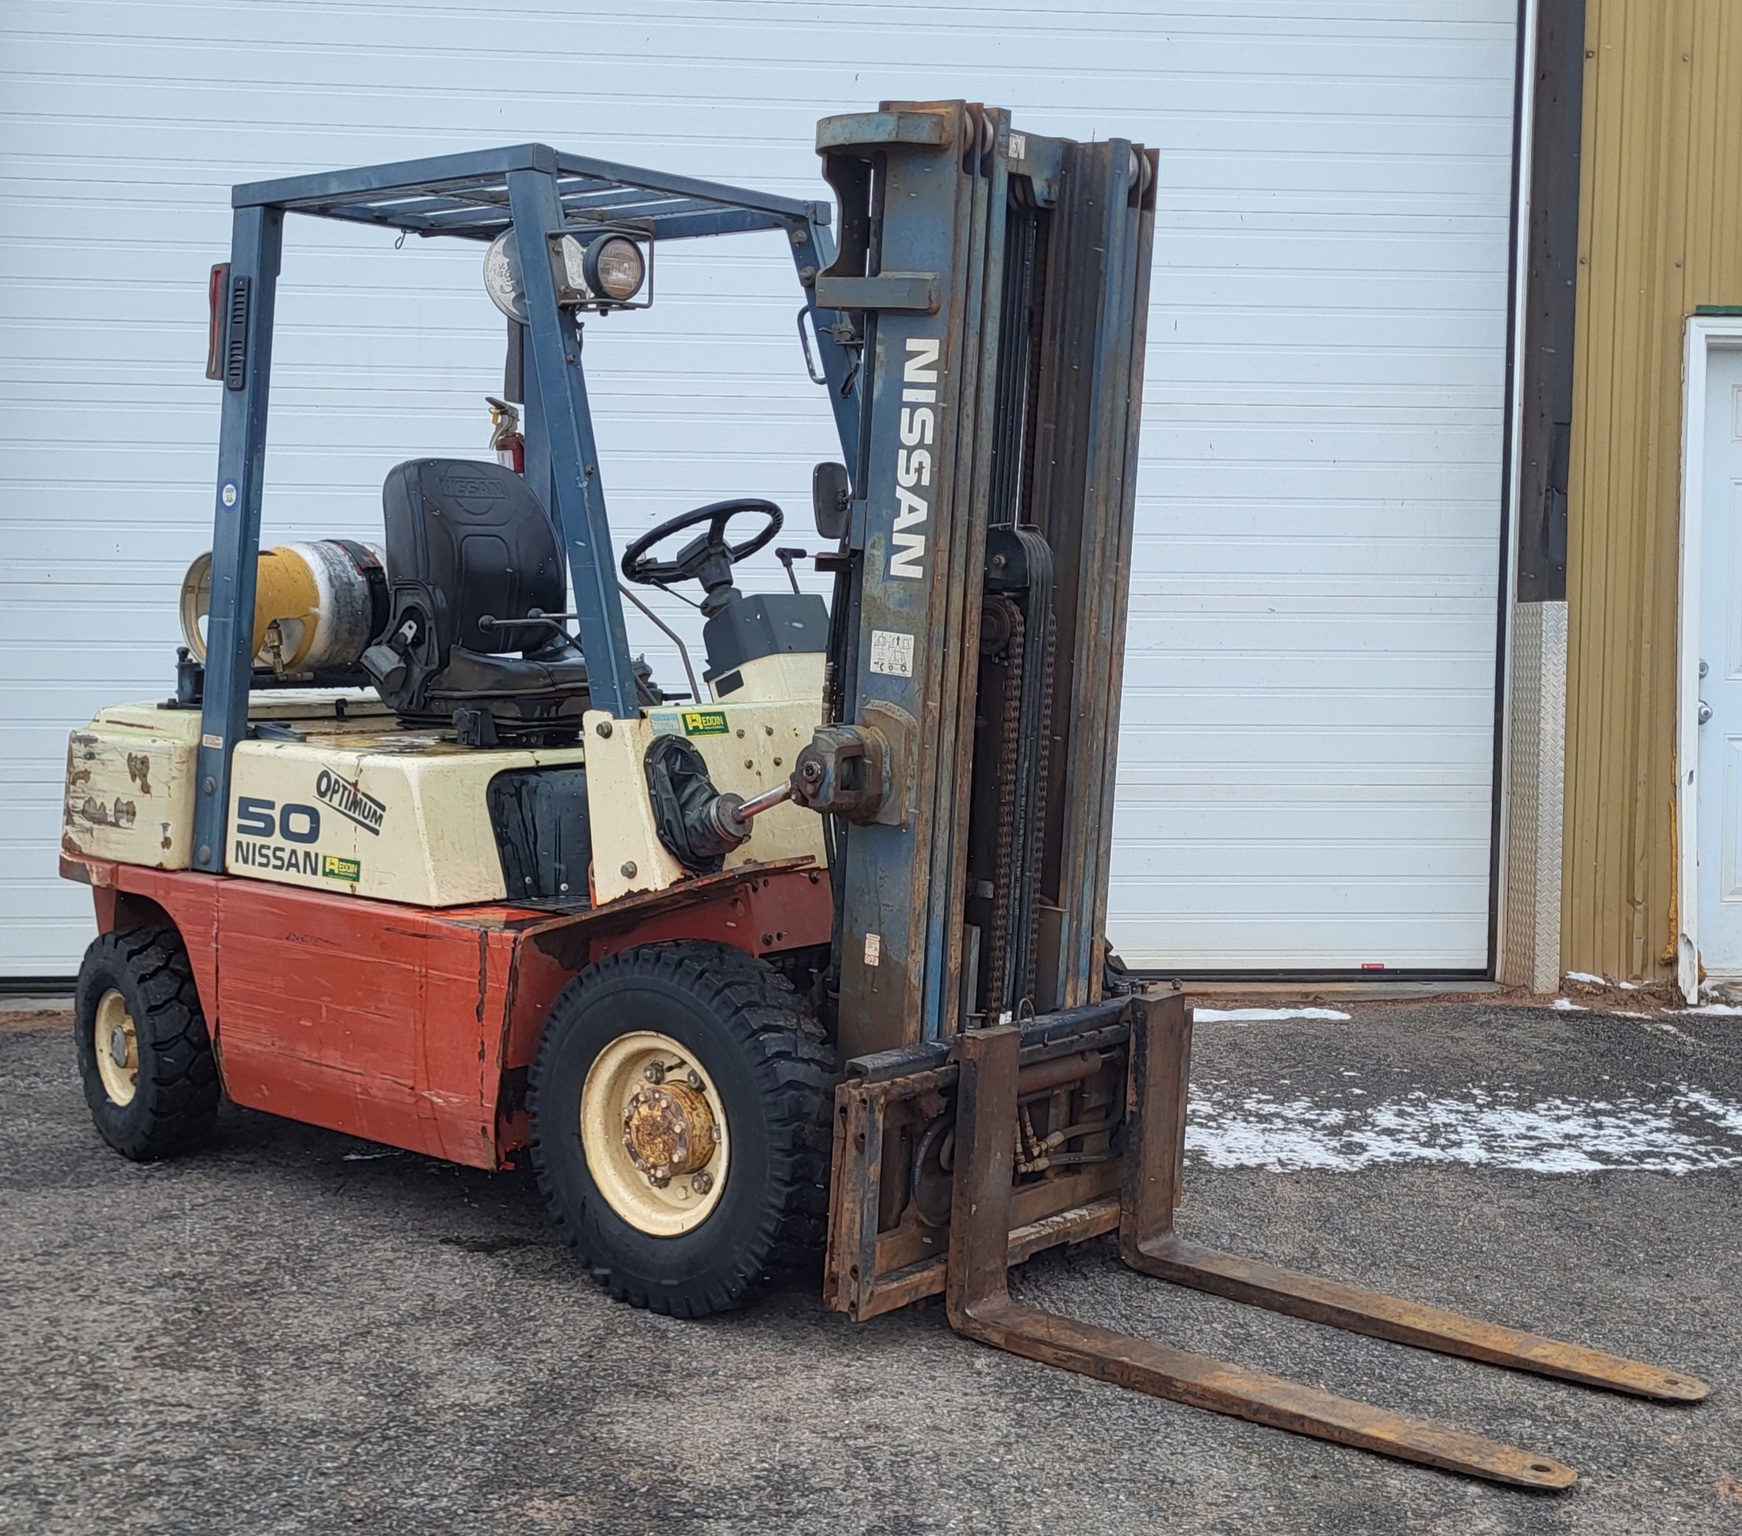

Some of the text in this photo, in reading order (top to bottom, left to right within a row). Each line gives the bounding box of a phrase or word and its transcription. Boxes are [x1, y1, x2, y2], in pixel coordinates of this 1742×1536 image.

[889, 338, 940, 579] NISSAN
[236, 796, 321, 844] 50
[316, 769, 384, 828] OPTIMUM
[234, 840, 319, 876] NISSAN
